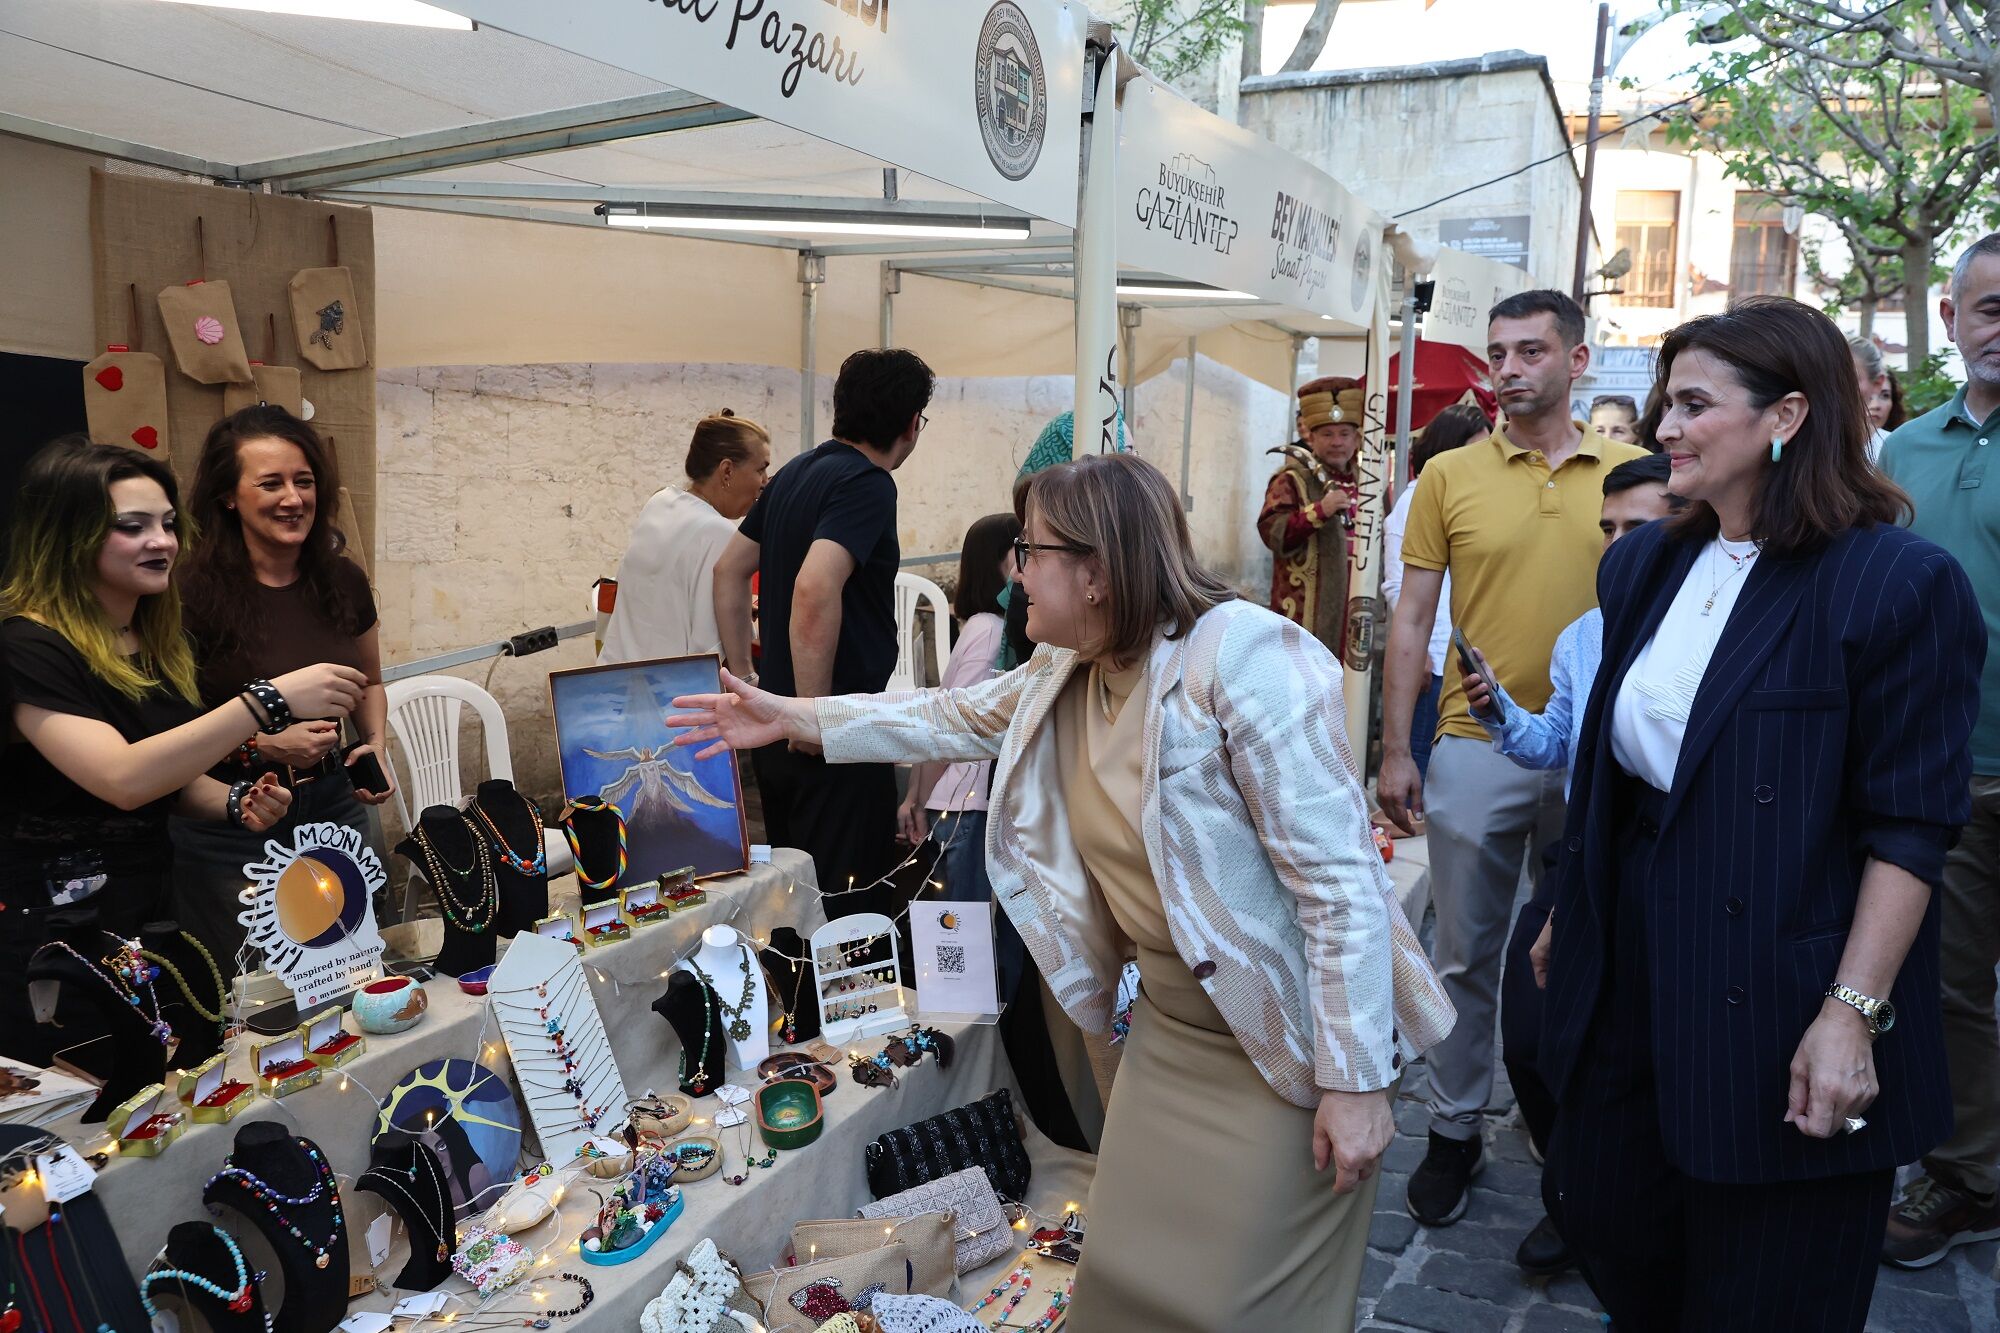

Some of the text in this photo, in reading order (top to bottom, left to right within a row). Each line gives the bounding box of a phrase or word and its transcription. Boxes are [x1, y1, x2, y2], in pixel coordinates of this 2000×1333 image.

[1159, 162, 1224, 210] BÜYÜKŞEHİR
[1136, 187, 1239, 255] GAZİANTEP
[1270, 191, 1342, 263] BEY MAHALLESİ
[1271, 243, 1304, 280] Sanat
[299, 826, 386, 884] MOON MY
[298, 975, 333, 993] crafted
[335, 970, 346, 979] by
[336, 957, 347, 966] by
